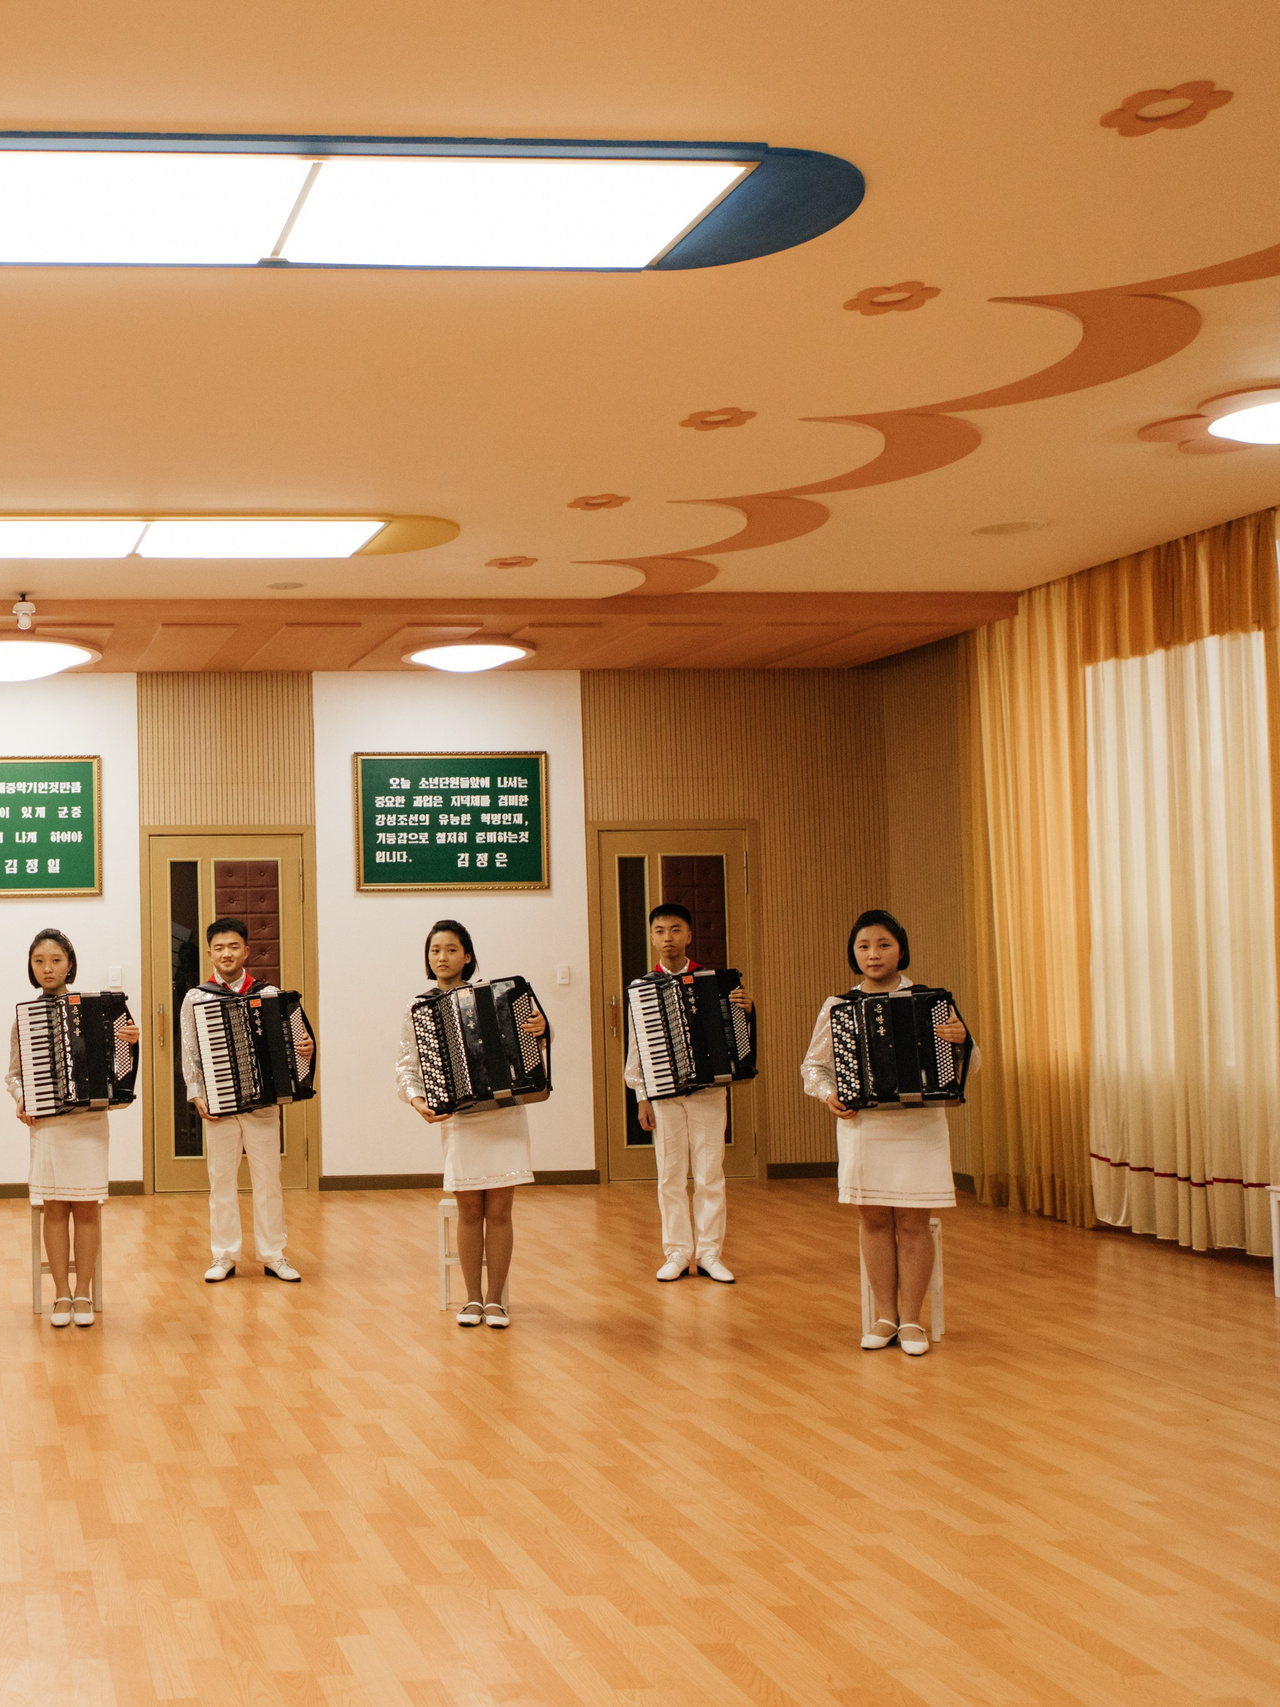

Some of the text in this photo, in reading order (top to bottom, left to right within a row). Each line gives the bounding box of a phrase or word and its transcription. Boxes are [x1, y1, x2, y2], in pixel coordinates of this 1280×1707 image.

[389, 776, 528, 790] 오늘 소년단원들앞에 나서는
[374, 796, 406, 808] 중요한
[412, 795, 443, 808] 과업은
[450, 795, 491, 807] 지덕체를
[21, 806, 46, 819] 있게
[57, 806, 82, 819] 군중
[375, 813, 529, 826] 강성조선의 유능한 혁명인재,
[15, 831, 37, 844] 나게
[50, 831, 83, 843] 하여야
[435, 832, 467, 844] 철저히
[475, 831, 529, 844] 준비하는것
[375, 851, 413, 863] 입니다.
